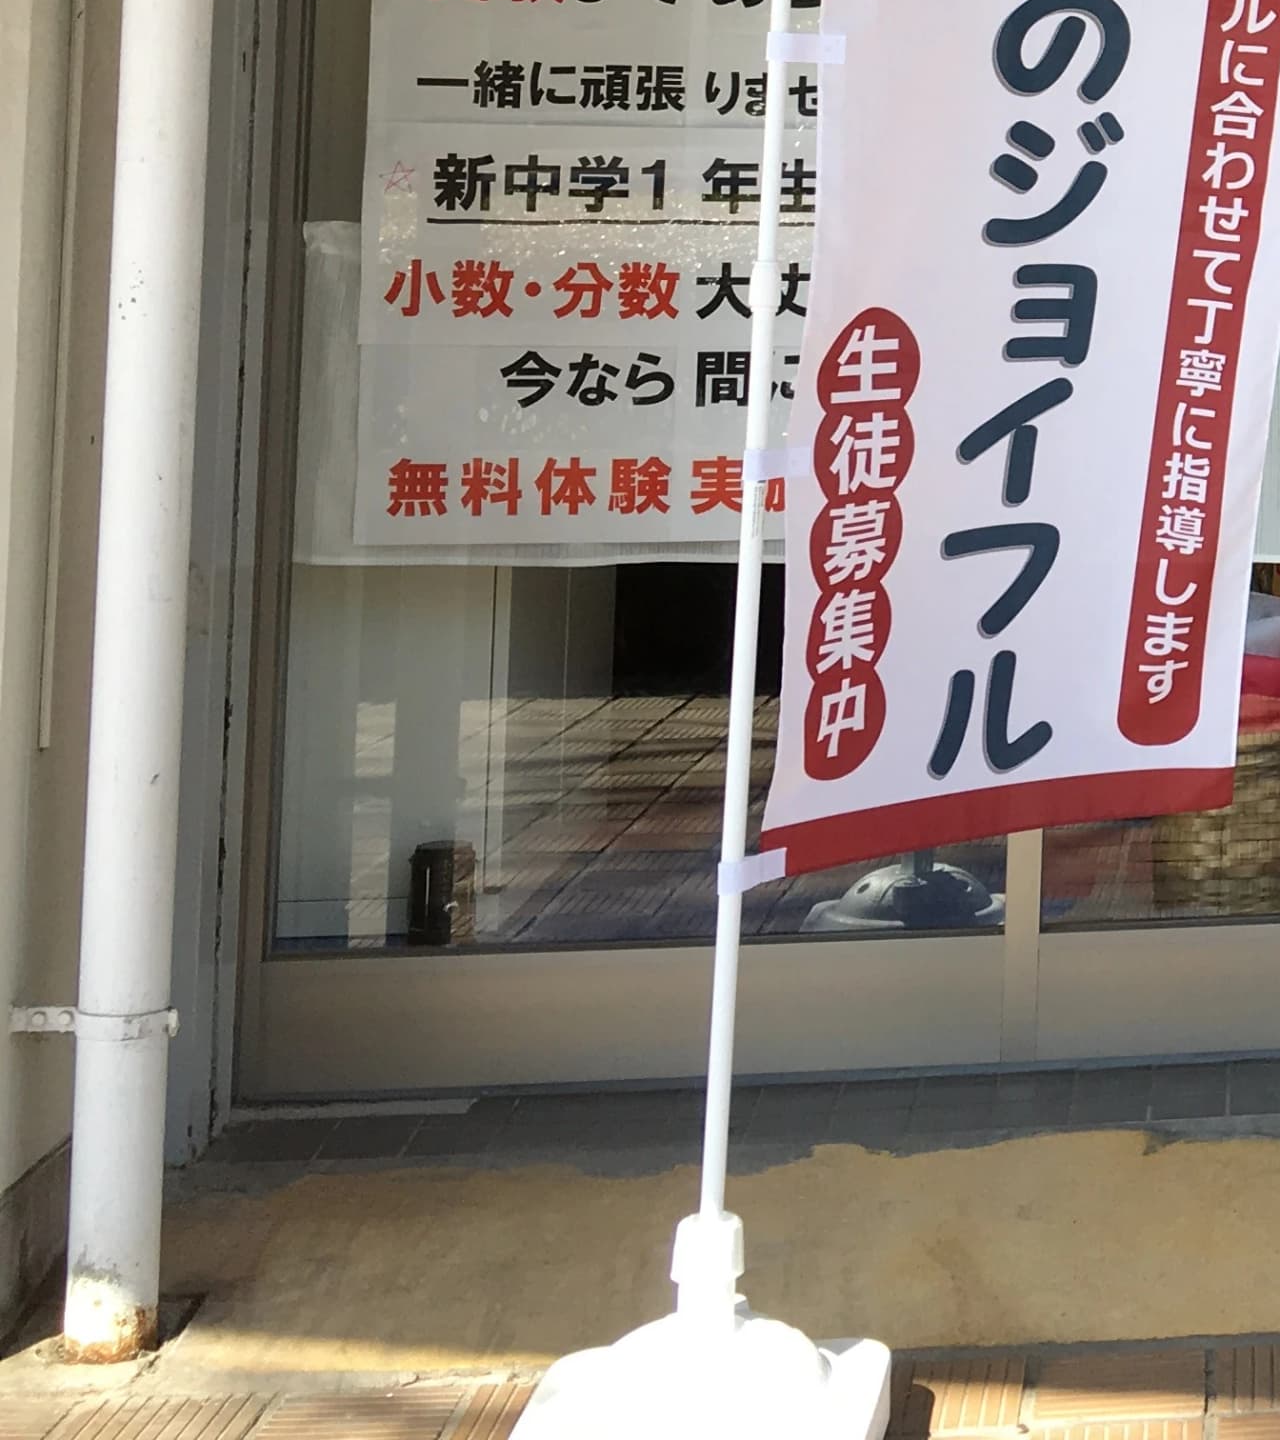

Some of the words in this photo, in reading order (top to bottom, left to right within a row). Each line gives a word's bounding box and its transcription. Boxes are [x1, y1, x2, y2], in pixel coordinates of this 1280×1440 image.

[814, 324, 904, 760] 生徒募集中
